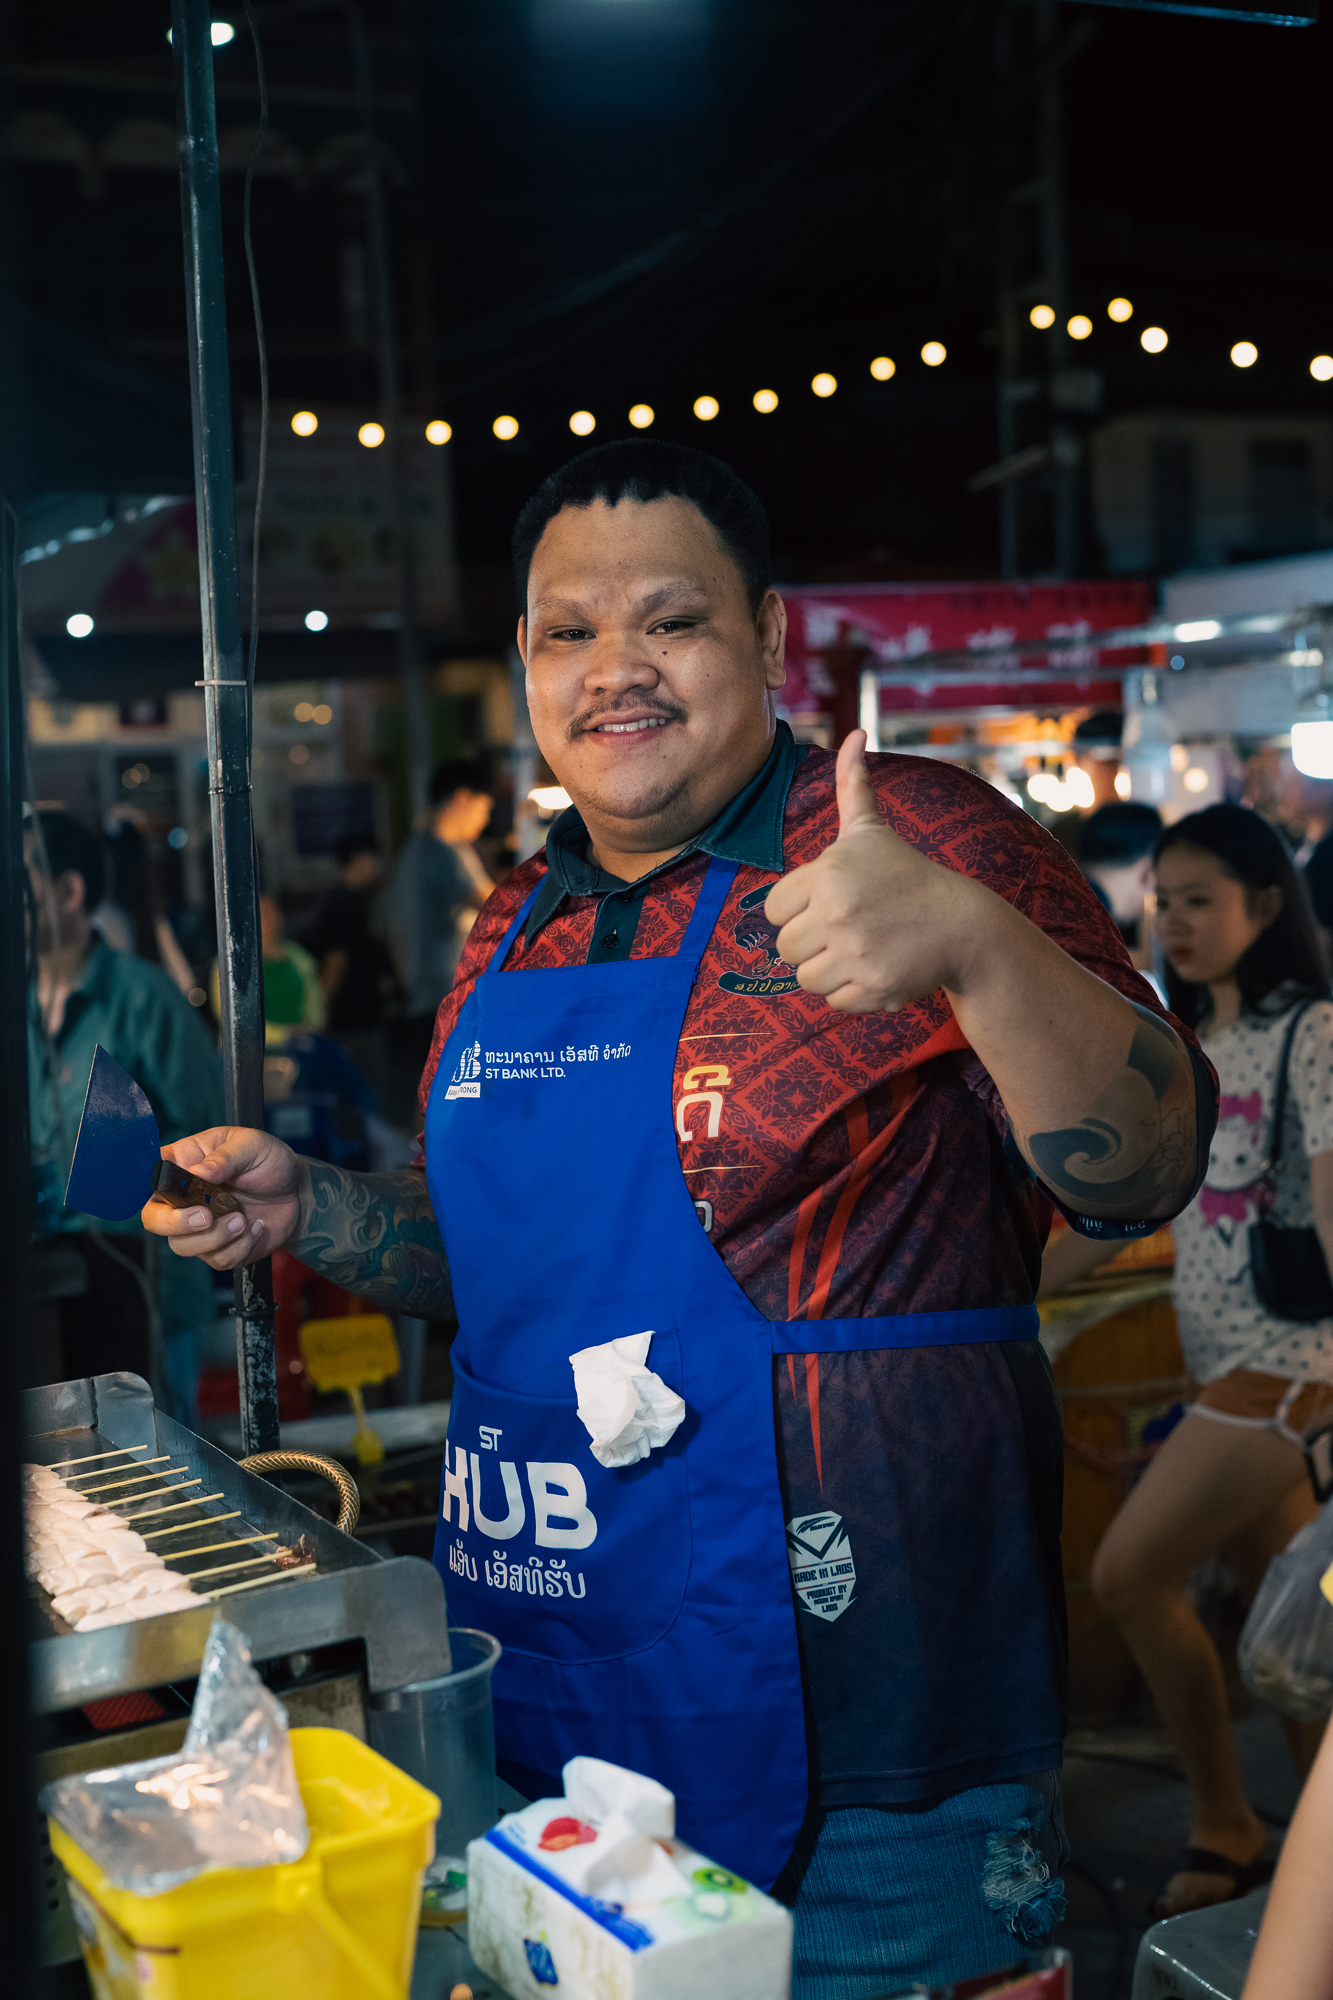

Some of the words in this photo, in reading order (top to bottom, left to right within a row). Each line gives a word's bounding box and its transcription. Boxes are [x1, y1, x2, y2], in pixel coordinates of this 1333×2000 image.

[485, 1051, 554, 1064] ທະນາຄານ
[485, 1067, 500, 1079] ST
[502, 1067, 539, 1079] BANK
[541, 1067, 566, 1078] LTD.
[479, 1425, 502, 1451] ST
[793, 1570, 817, 1583] MADE
[819, 1567, 828, 1579] IN
[830, 1562, 853, 1577] LAOS
[807, 1586, 836, 1600] PRODUCT
[838, 1584, 847, 1593] BY
[822, 1603, 838, 1613] LAOS
